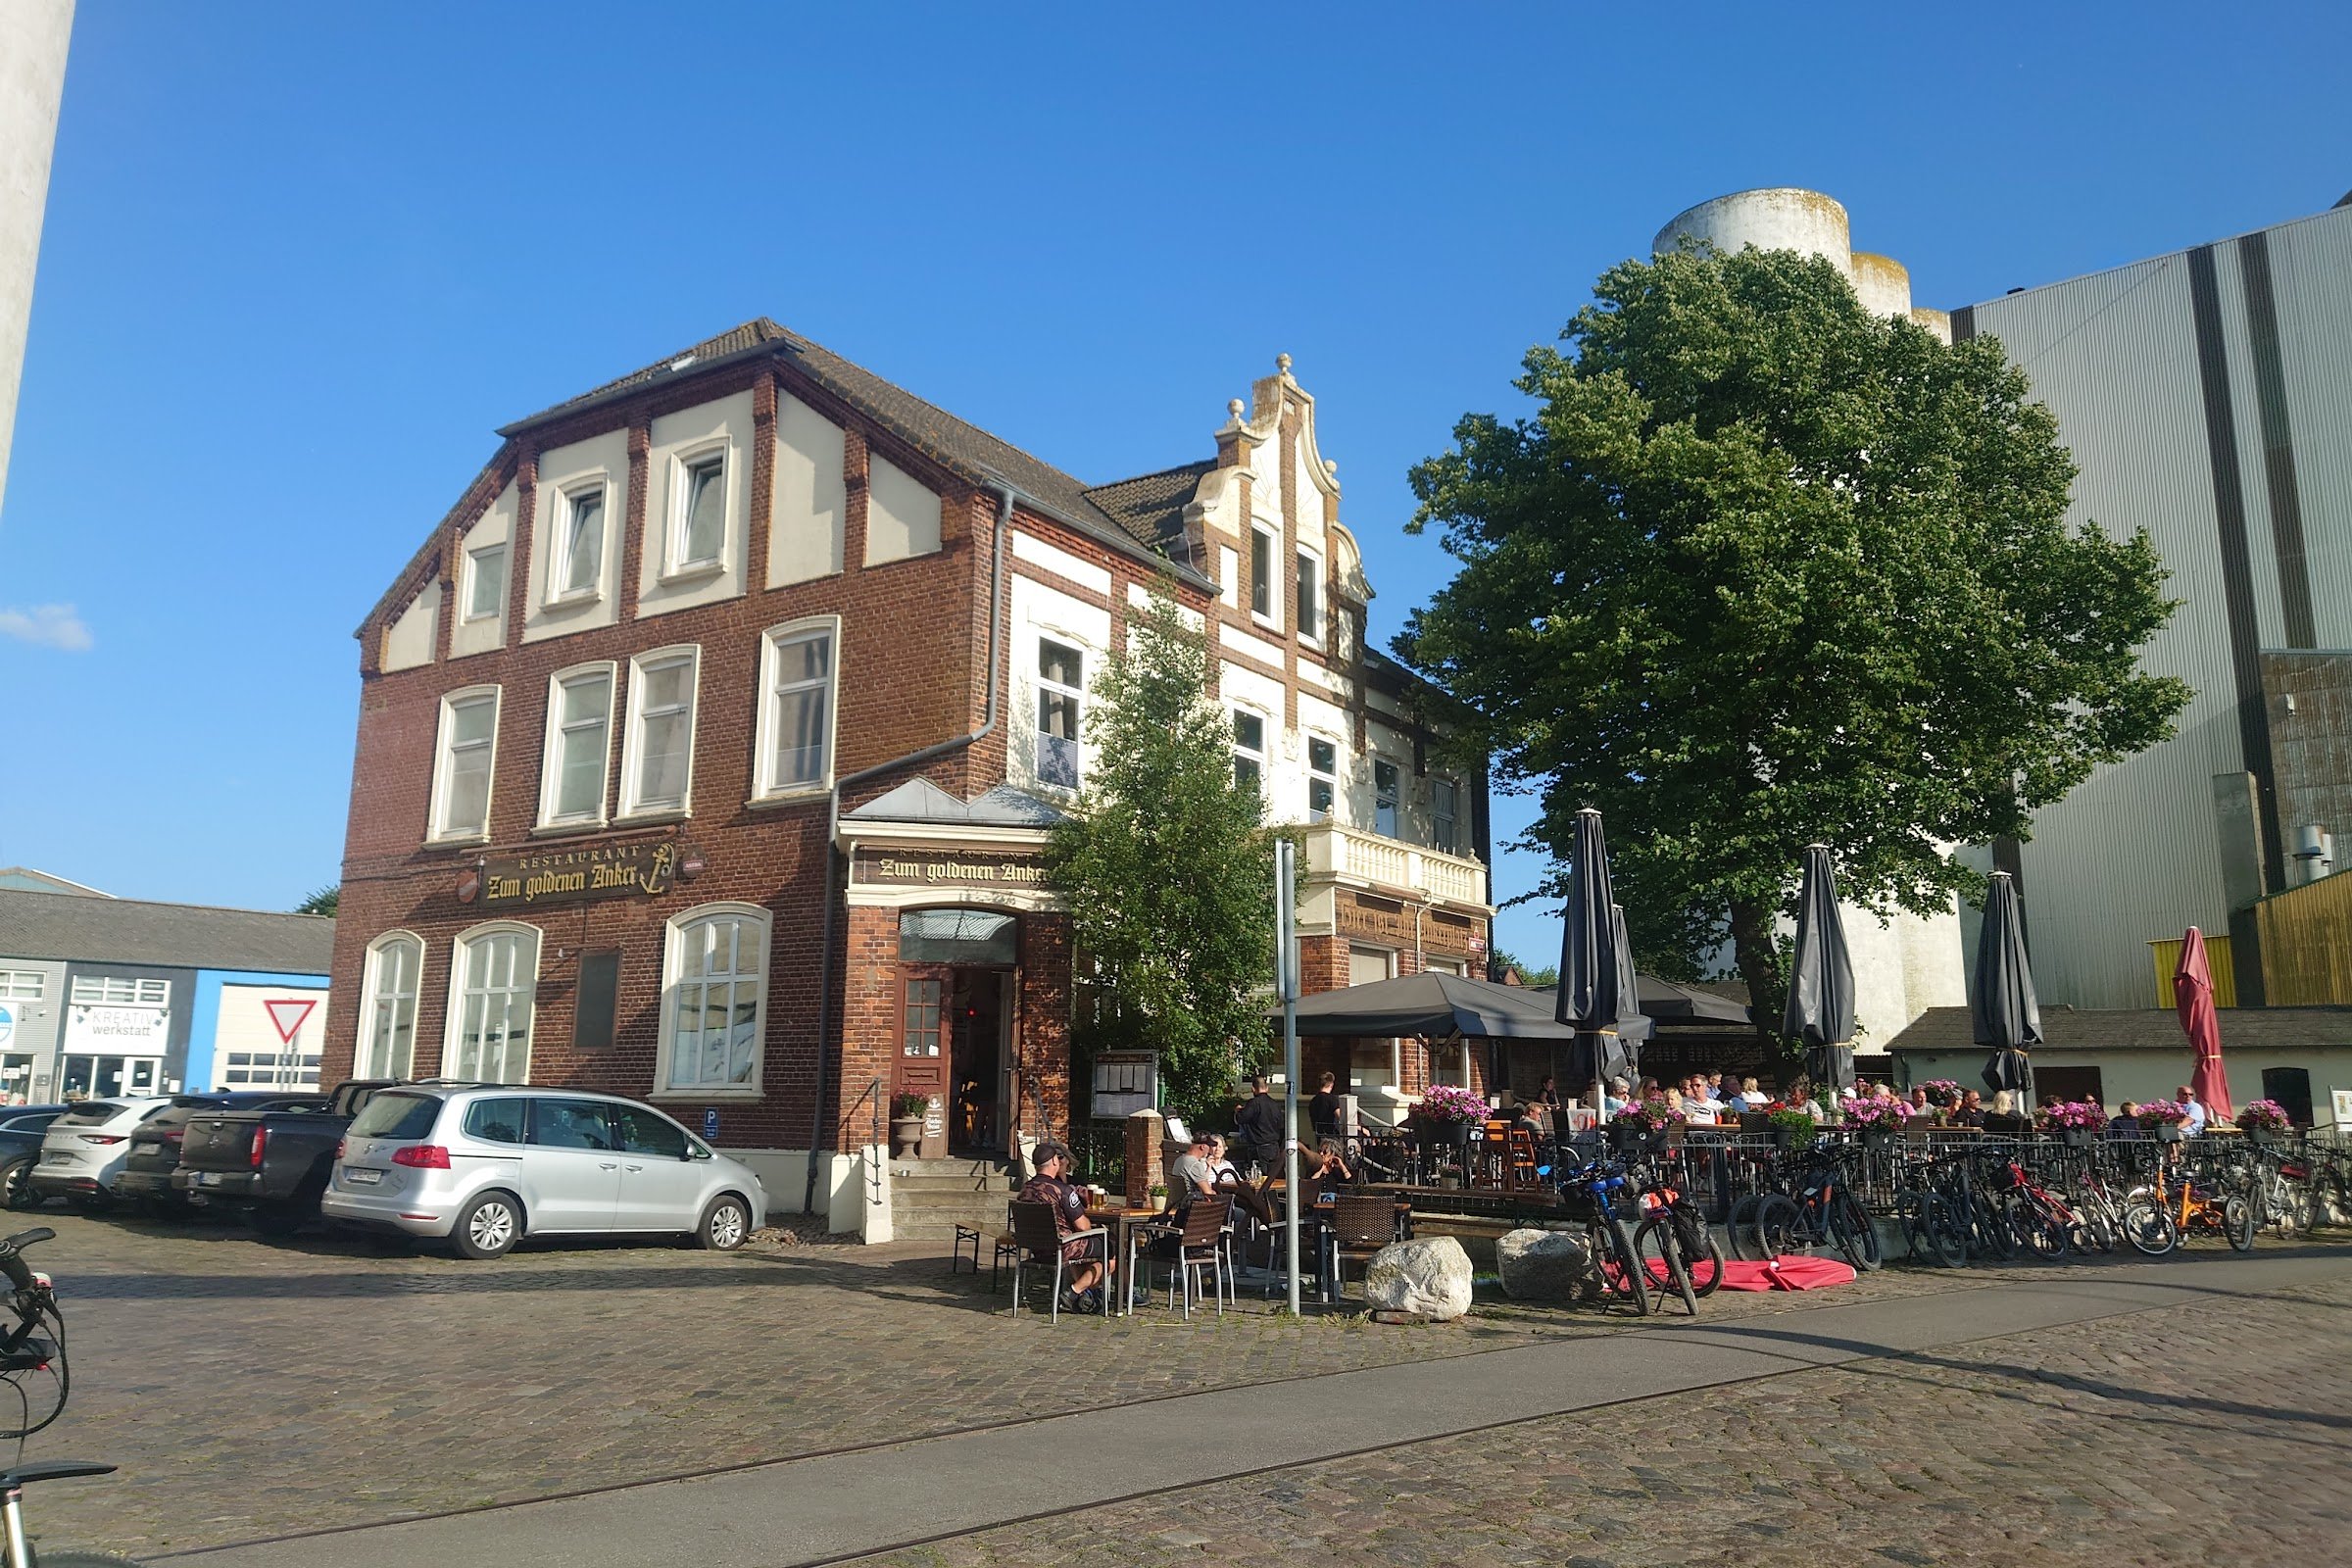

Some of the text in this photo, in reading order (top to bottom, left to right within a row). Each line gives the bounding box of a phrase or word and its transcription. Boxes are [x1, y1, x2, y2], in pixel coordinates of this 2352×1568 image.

[519, 845, 639, 870] RESTAURANT
[899, 847, 1033, 861] RESTAURANT
[879, 858, 919, 878] Zum
[926, 860, 994, 883] goldenen
[487, 861, 637, 902] Zum goldenen Anker
[93, 1011, 154, 1025] KREATIV
[93, 1023, 151, 1037] werkstatt
[708, 1110, 716, 1124] P
